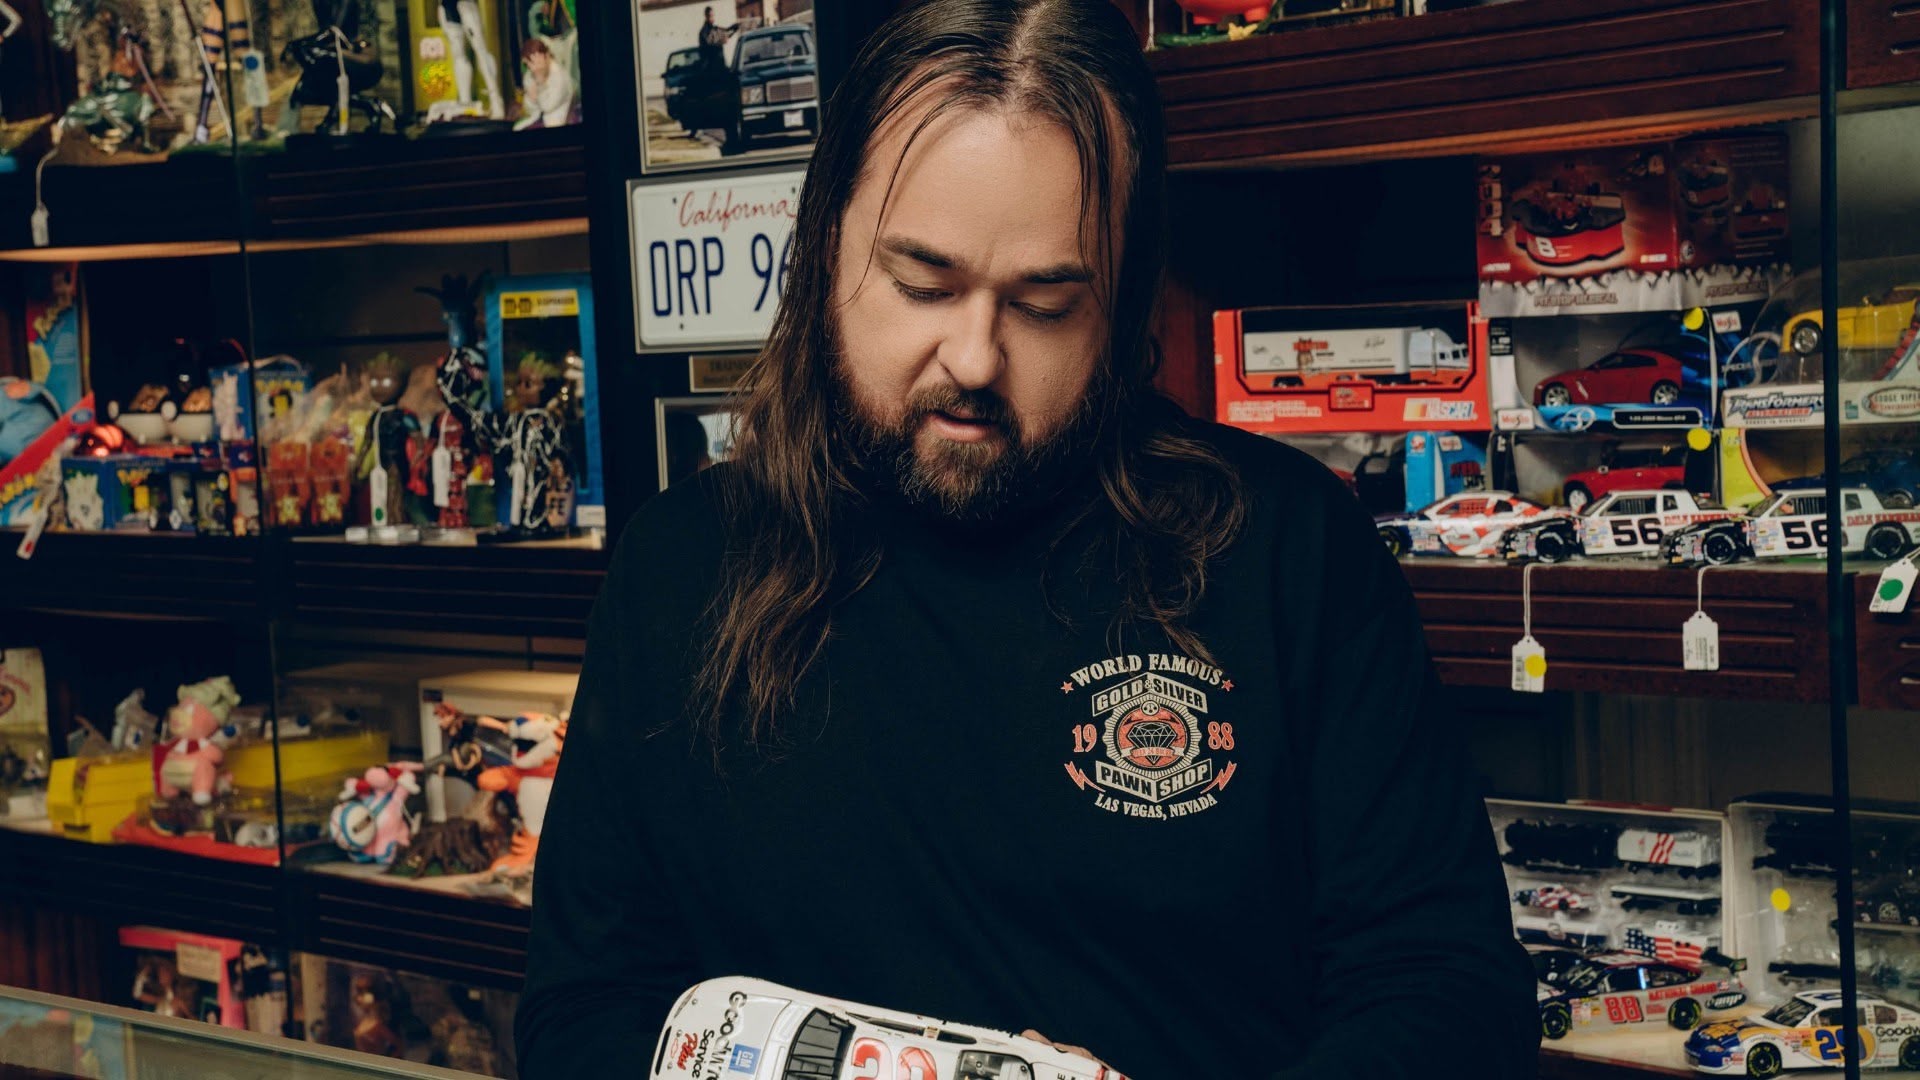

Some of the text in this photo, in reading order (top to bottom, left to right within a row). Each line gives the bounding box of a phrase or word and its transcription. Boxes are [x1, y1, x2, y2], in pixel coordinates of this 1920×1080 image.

[679, 189, 797, 232] California
[1536, 237, 1556, 257] 8
[1610, 517, 1664, 546] 56
[1070, 653, 1223, 687] WORLD FAMOUS
[1097, 678, 1203, 711] GOLD & SILVER
[1072, 723, 1097, 753] 19
[1207, 721, 1235, 751] 88
[1101, 764, 1208, 797] PAWN SHOP
[1094, 793, 1218, 821] LAS VEGAS, NEVADA
[1604, 996, 1644, 1024] 88
[691, 1029, 715, 1078] Service
